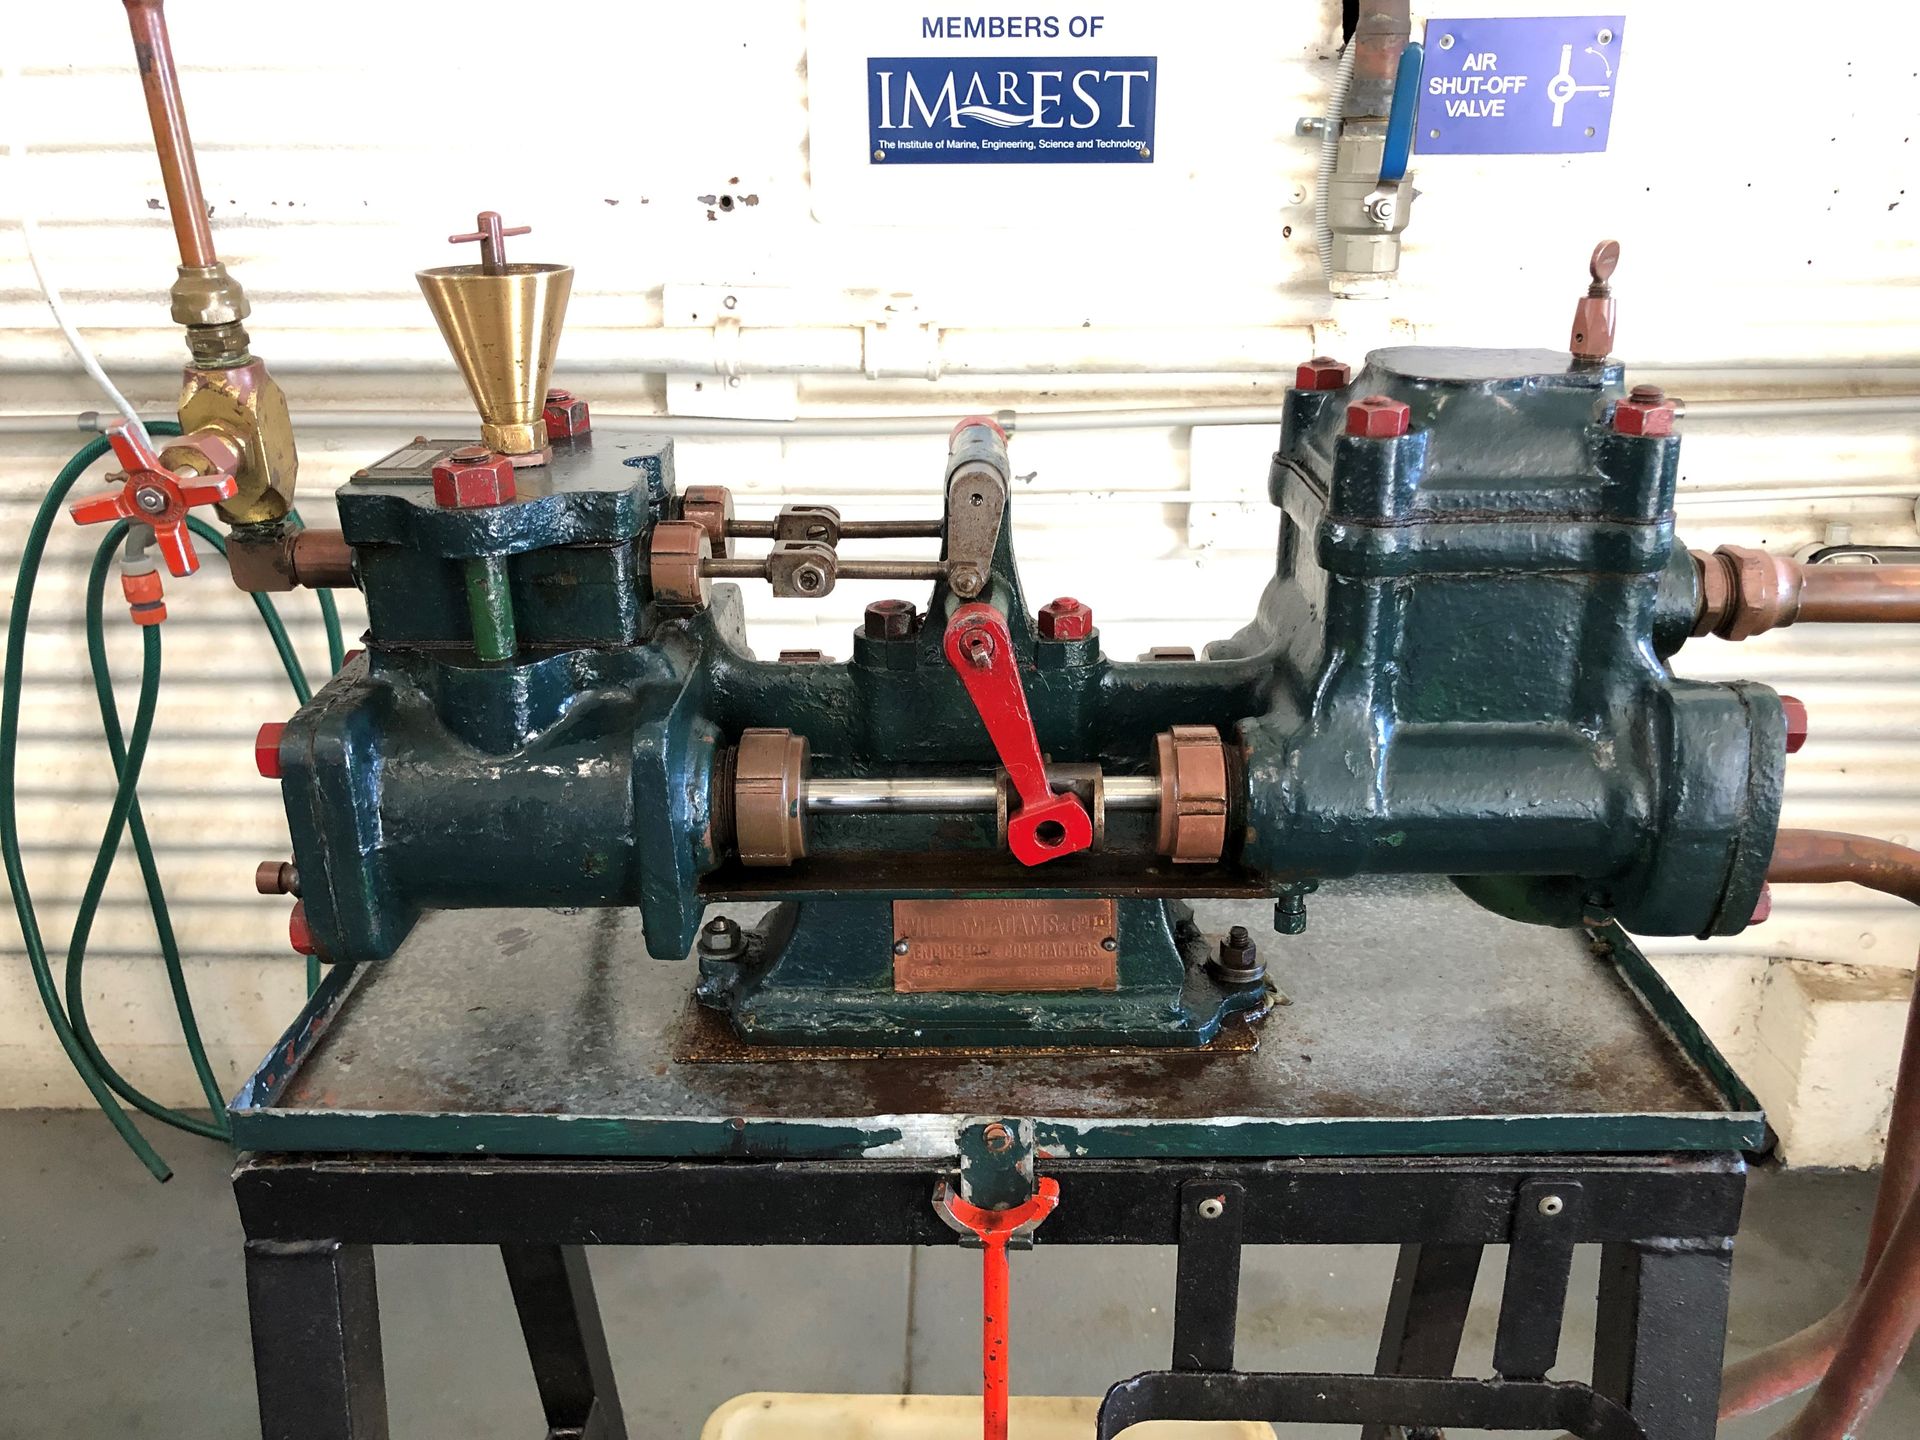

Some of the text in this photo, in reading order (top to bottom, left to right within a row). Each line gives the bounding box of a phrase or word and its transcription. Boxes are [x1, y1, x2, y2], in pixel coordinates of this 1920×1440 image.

[922, 15, 1105, 38] MEMBERS OF
[1462, 53, 1497, 71] AIR
[1428, 76, 1528, 94] SHUT-OFF
[1445, 99, 1506, 117] VALVE
[878, 139, 1147, 151] The Institute of Marine, Engineering, Science and Technology
